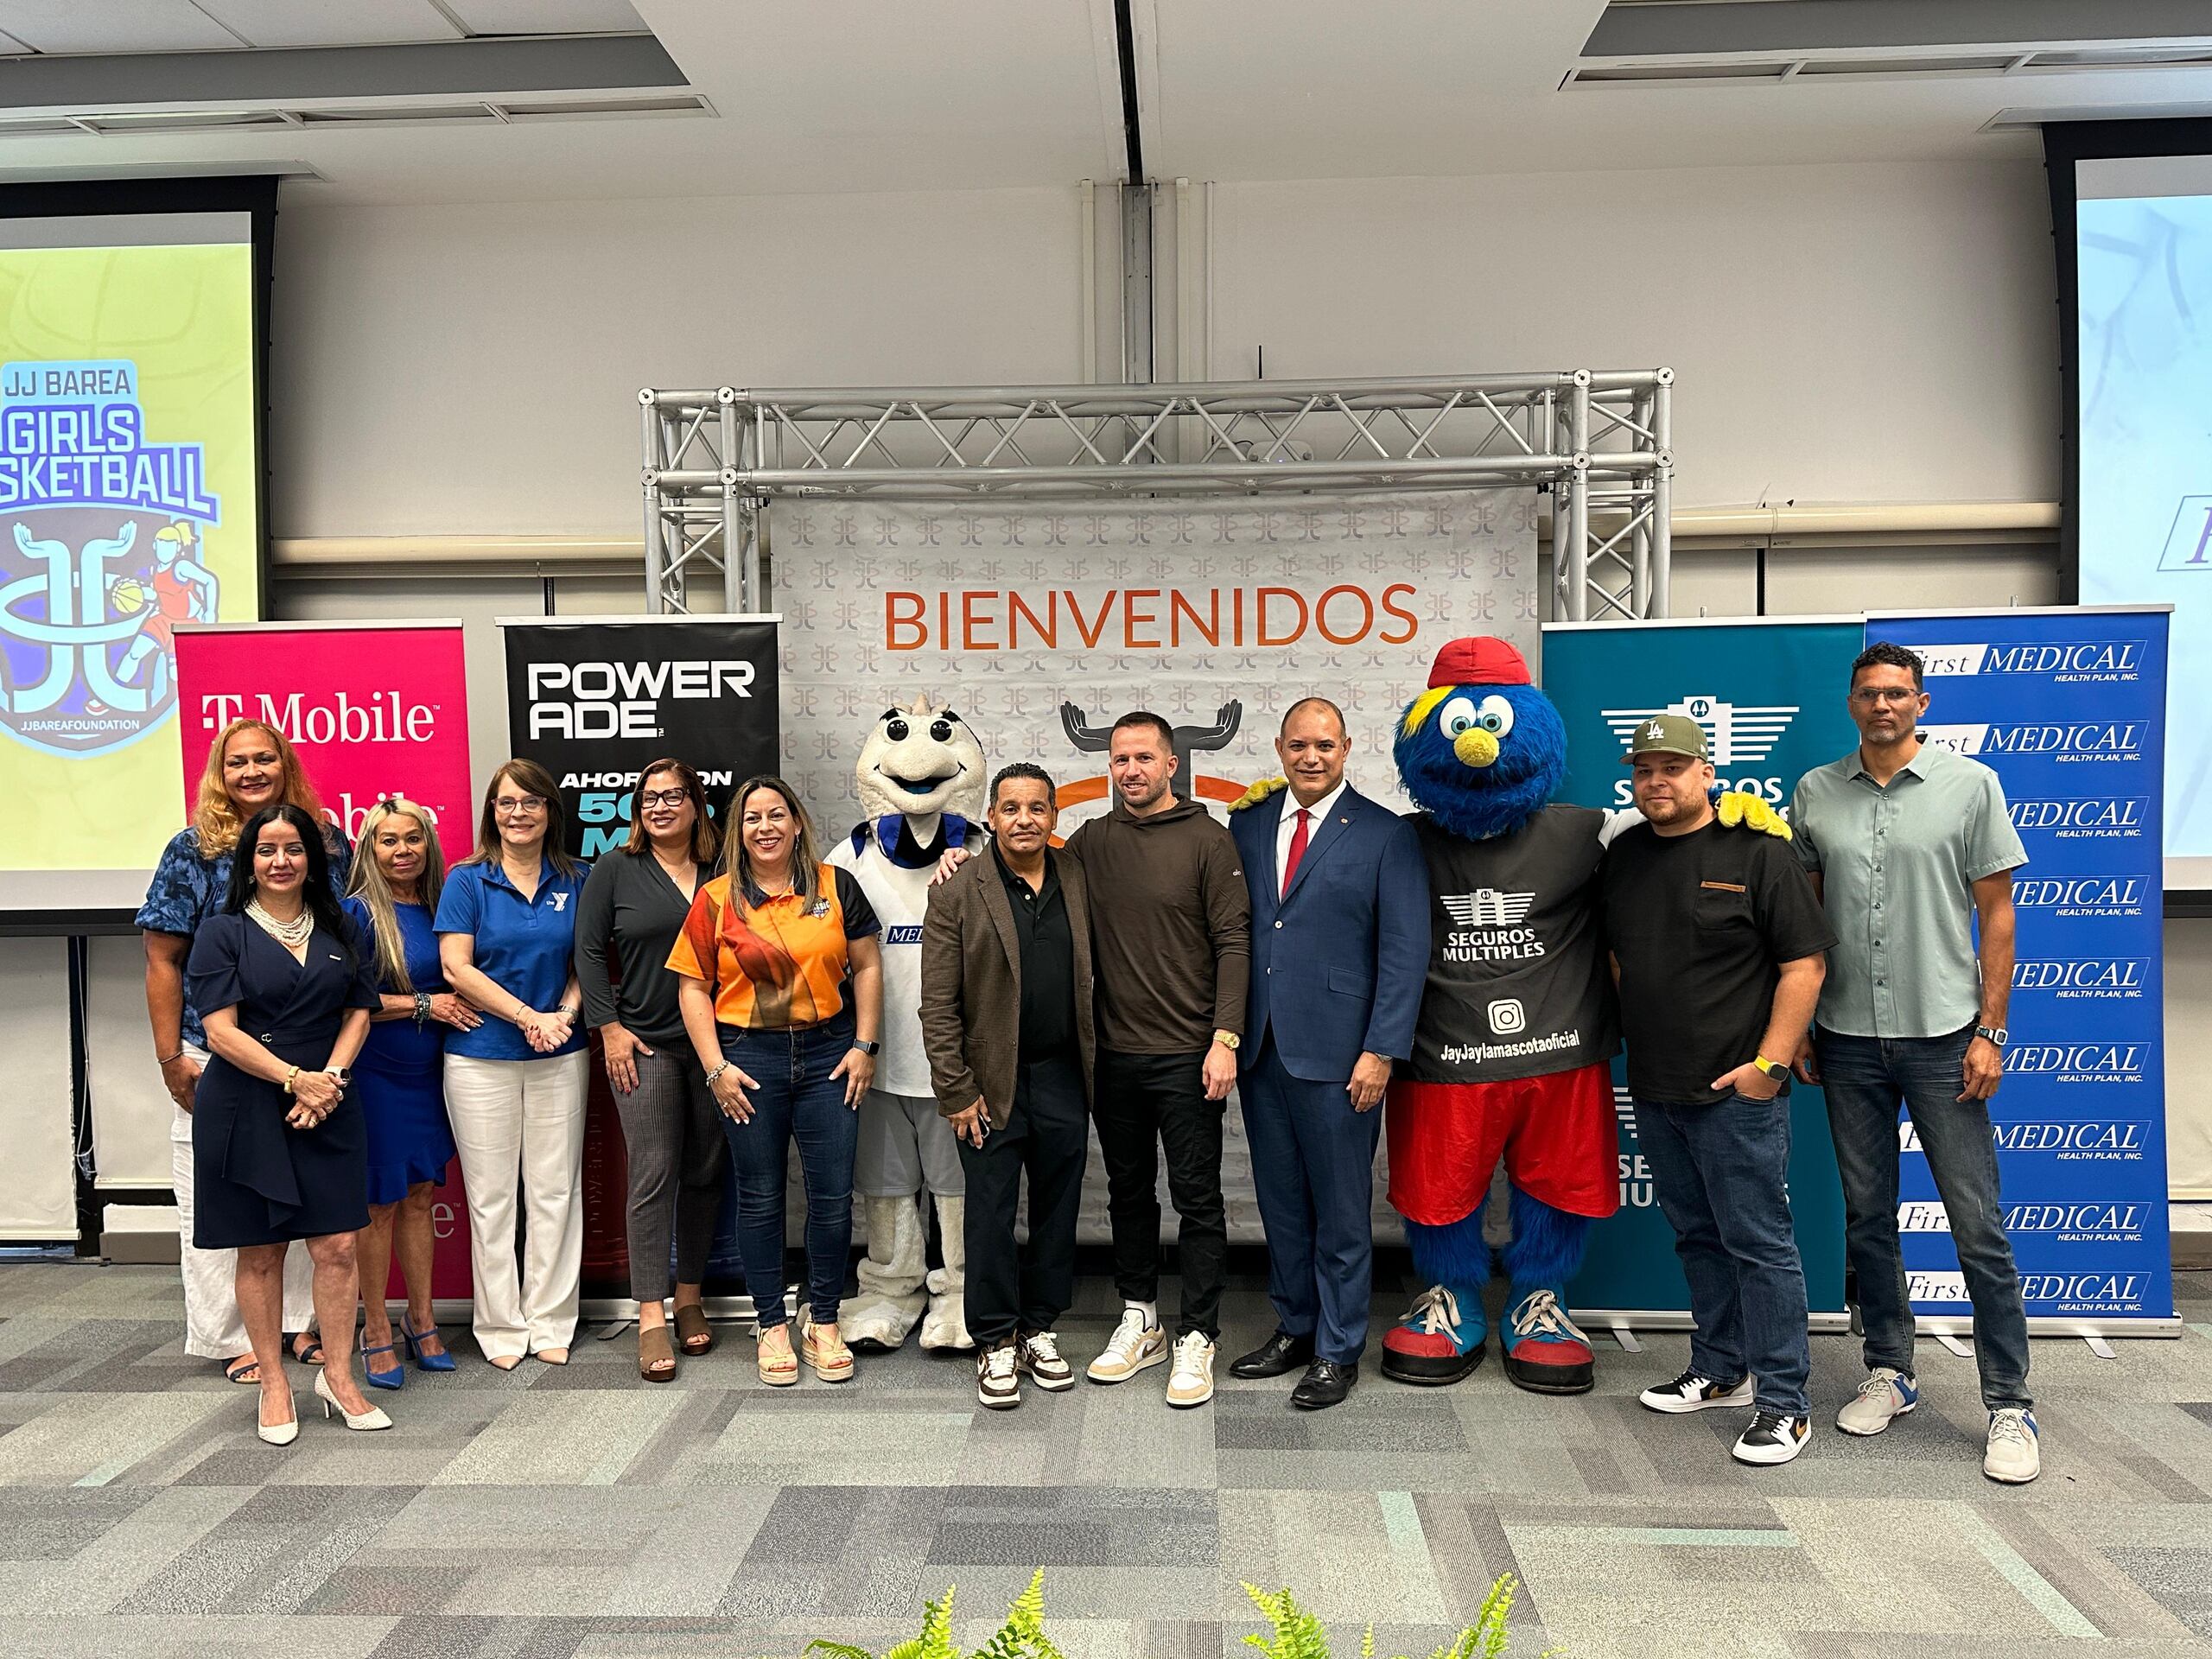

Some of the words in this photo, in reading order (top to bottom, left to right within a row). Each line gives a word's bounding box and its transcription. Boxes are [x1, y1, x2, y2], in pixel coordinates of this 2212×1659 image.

[5, 371, 36, 397] JJ
[46, 369, 131, 396] BAREA
[8, 409, 136, 454] GIRLS
[886, 583, 1419, 651] BIENVENIDOS
[1984, 645, 2135, 672] MEDICAL
[528, 661, 755, 701] POWER
[2055, 674, 2089, 683] HEALTH
[2092, 673, 2118, 682] PLAN,
[2121, 672, 2139, 681] INC.
[21, 720, 140, 731] JJBAREAFOUNDATION
[530, 701, 658, 741] ADE
[1647, 720, 1664, 740] LA
[1985, 725, 2138, 752] MEDICAL
[2094, 753, 2120, 762] PLAN,
[2123, 753, 2140, 761] INC.
[1448, 928, 1535, 947] SEGUROS
[1442, 941, 1546, 963] MULTIPLES
[2011, 962, 2139, 988] EDICAL
[1440, 1029, 1580, 1065] JayJaylamascotaoficial
[2094, 1074, 2121, 1083] PLAN,
[2125, 1074, 2143, 1083] INC.
[1993, 1124, 2139, 1149] MEDICAL
[2095, 1233, 2121, 1242] PLAN,
[2124, 1233, 2142, 1242] INC.
[2095, 1303, 2121, 1312] PLAN,
